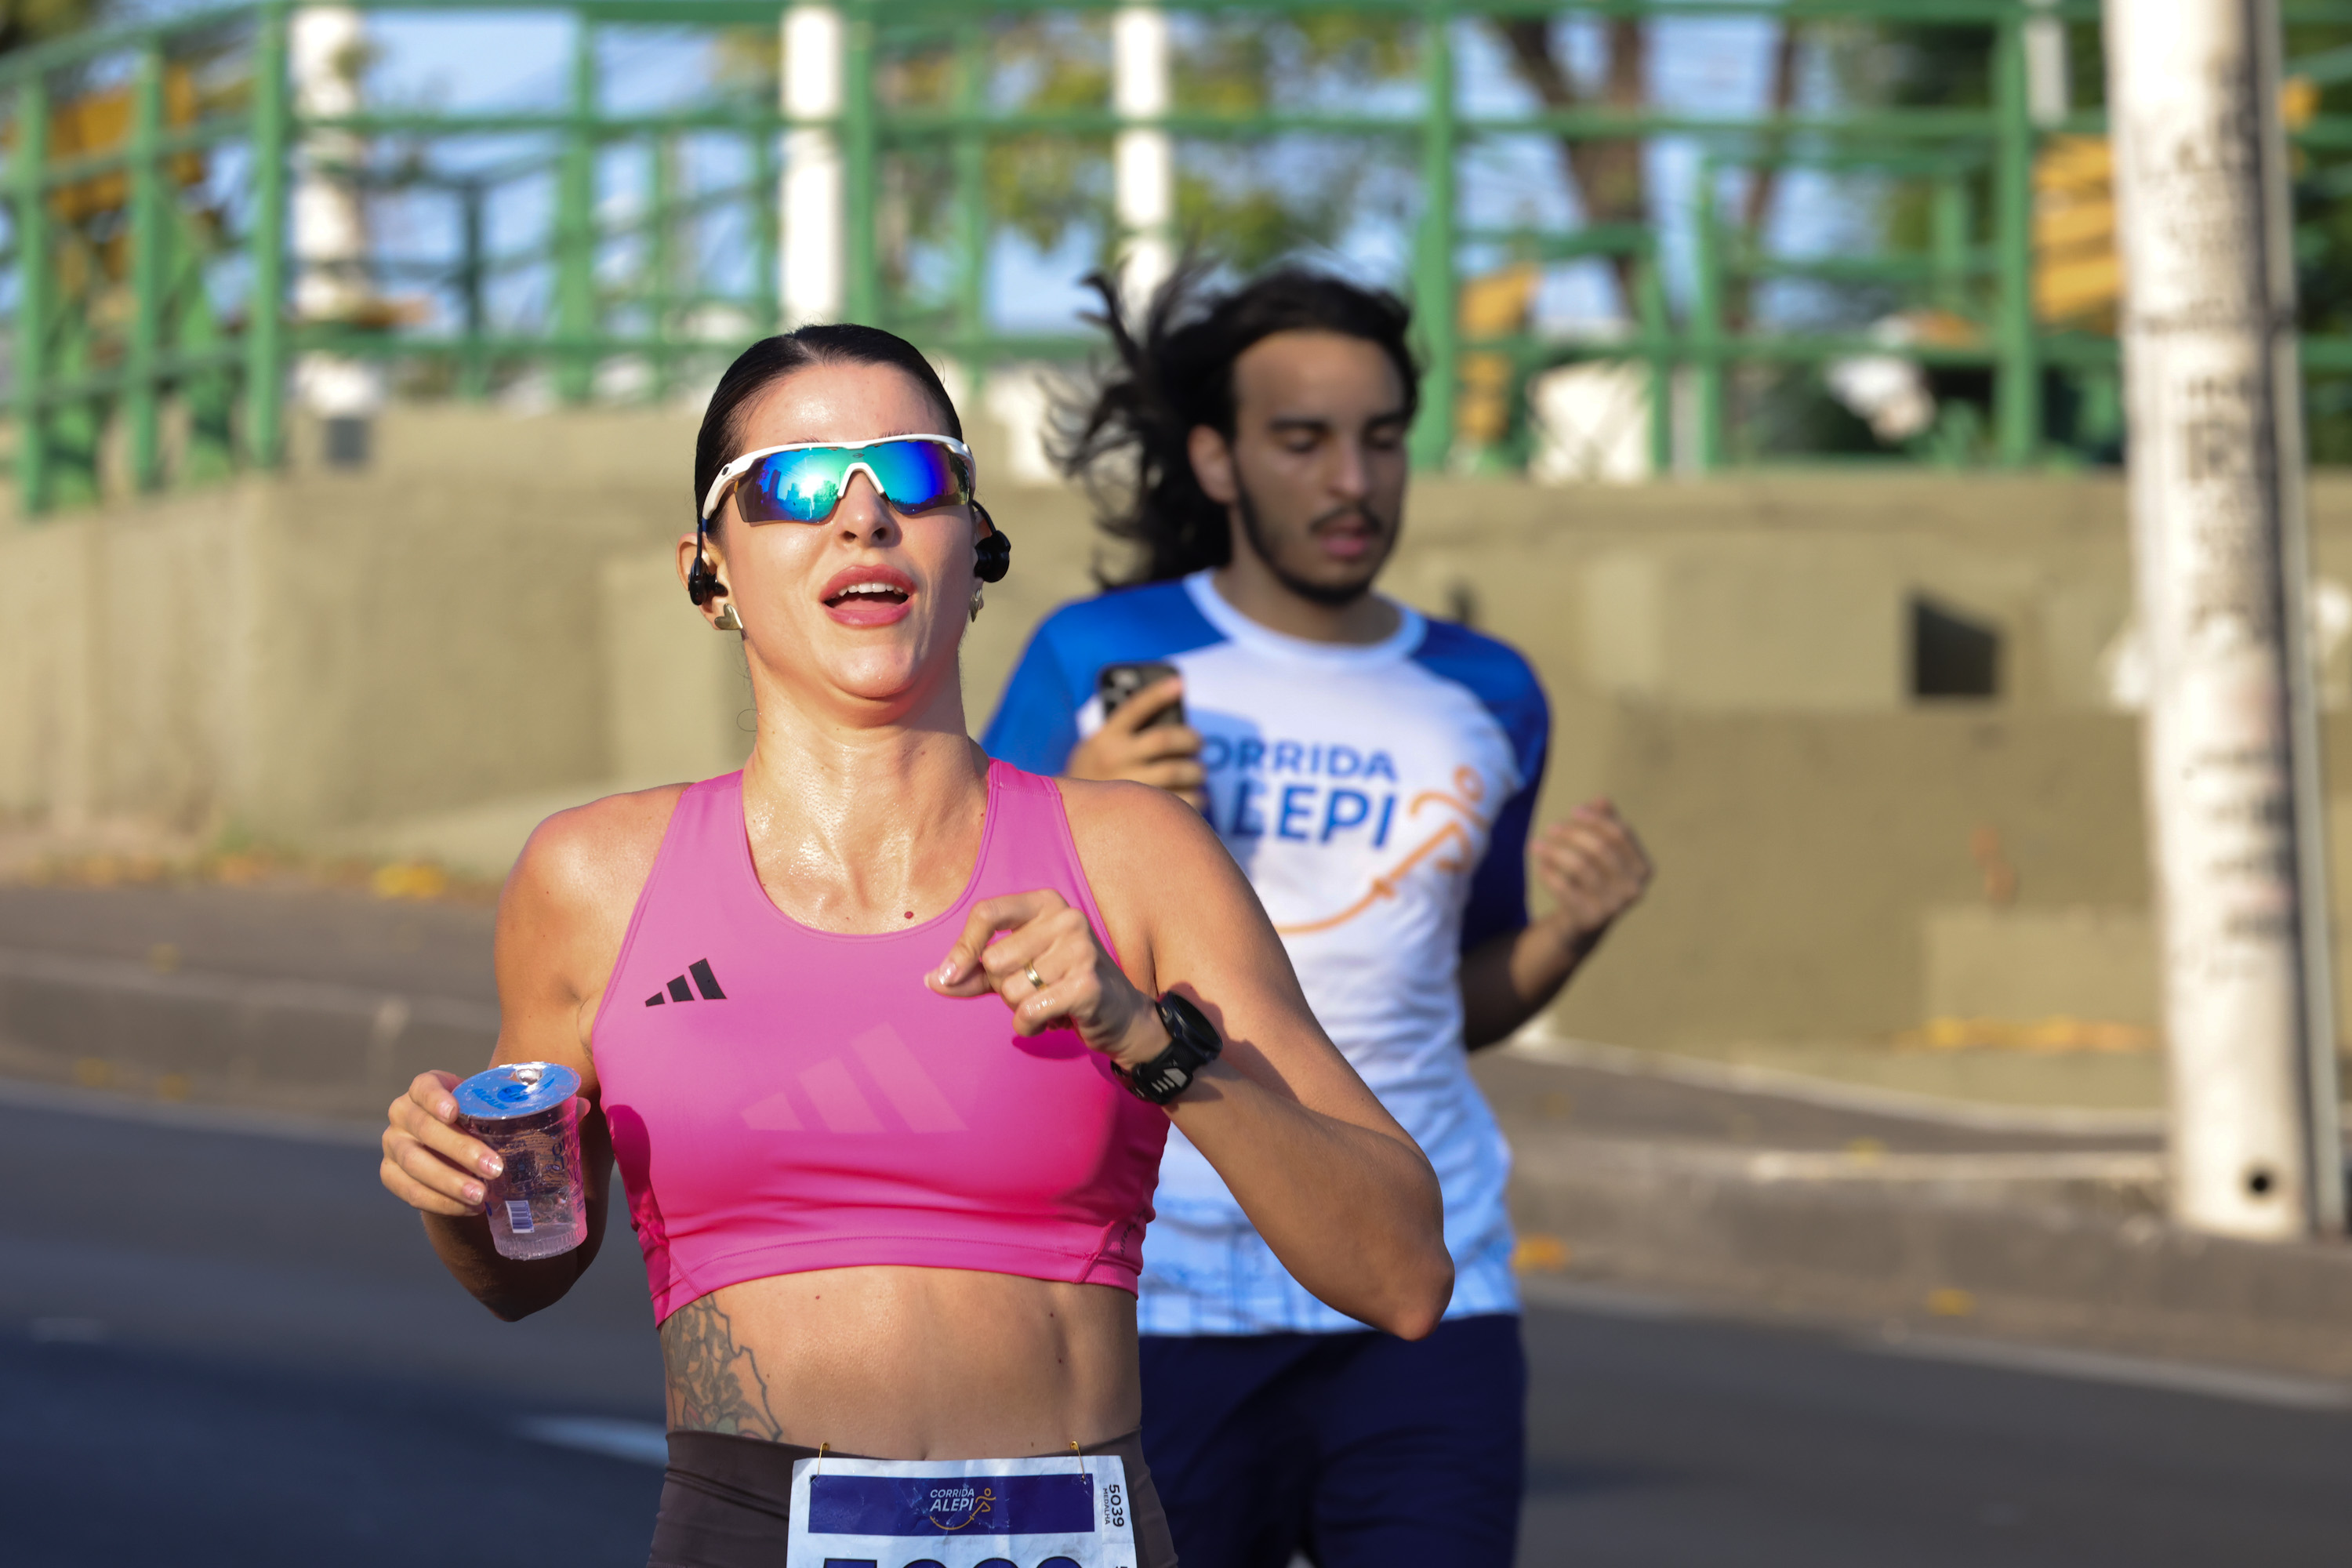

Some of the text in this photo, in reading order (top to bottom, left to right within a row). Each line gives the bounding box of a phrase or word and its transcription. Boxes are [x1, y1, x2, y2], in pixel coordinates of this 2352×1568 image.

[1201, 734, 1398, 782] ORRIDA
[929, 1497, 975, 1512] ALEPI
[930, 1488, 975, 1499] CORRIDA
[1109, 1483, 1124, 1527] 5039
